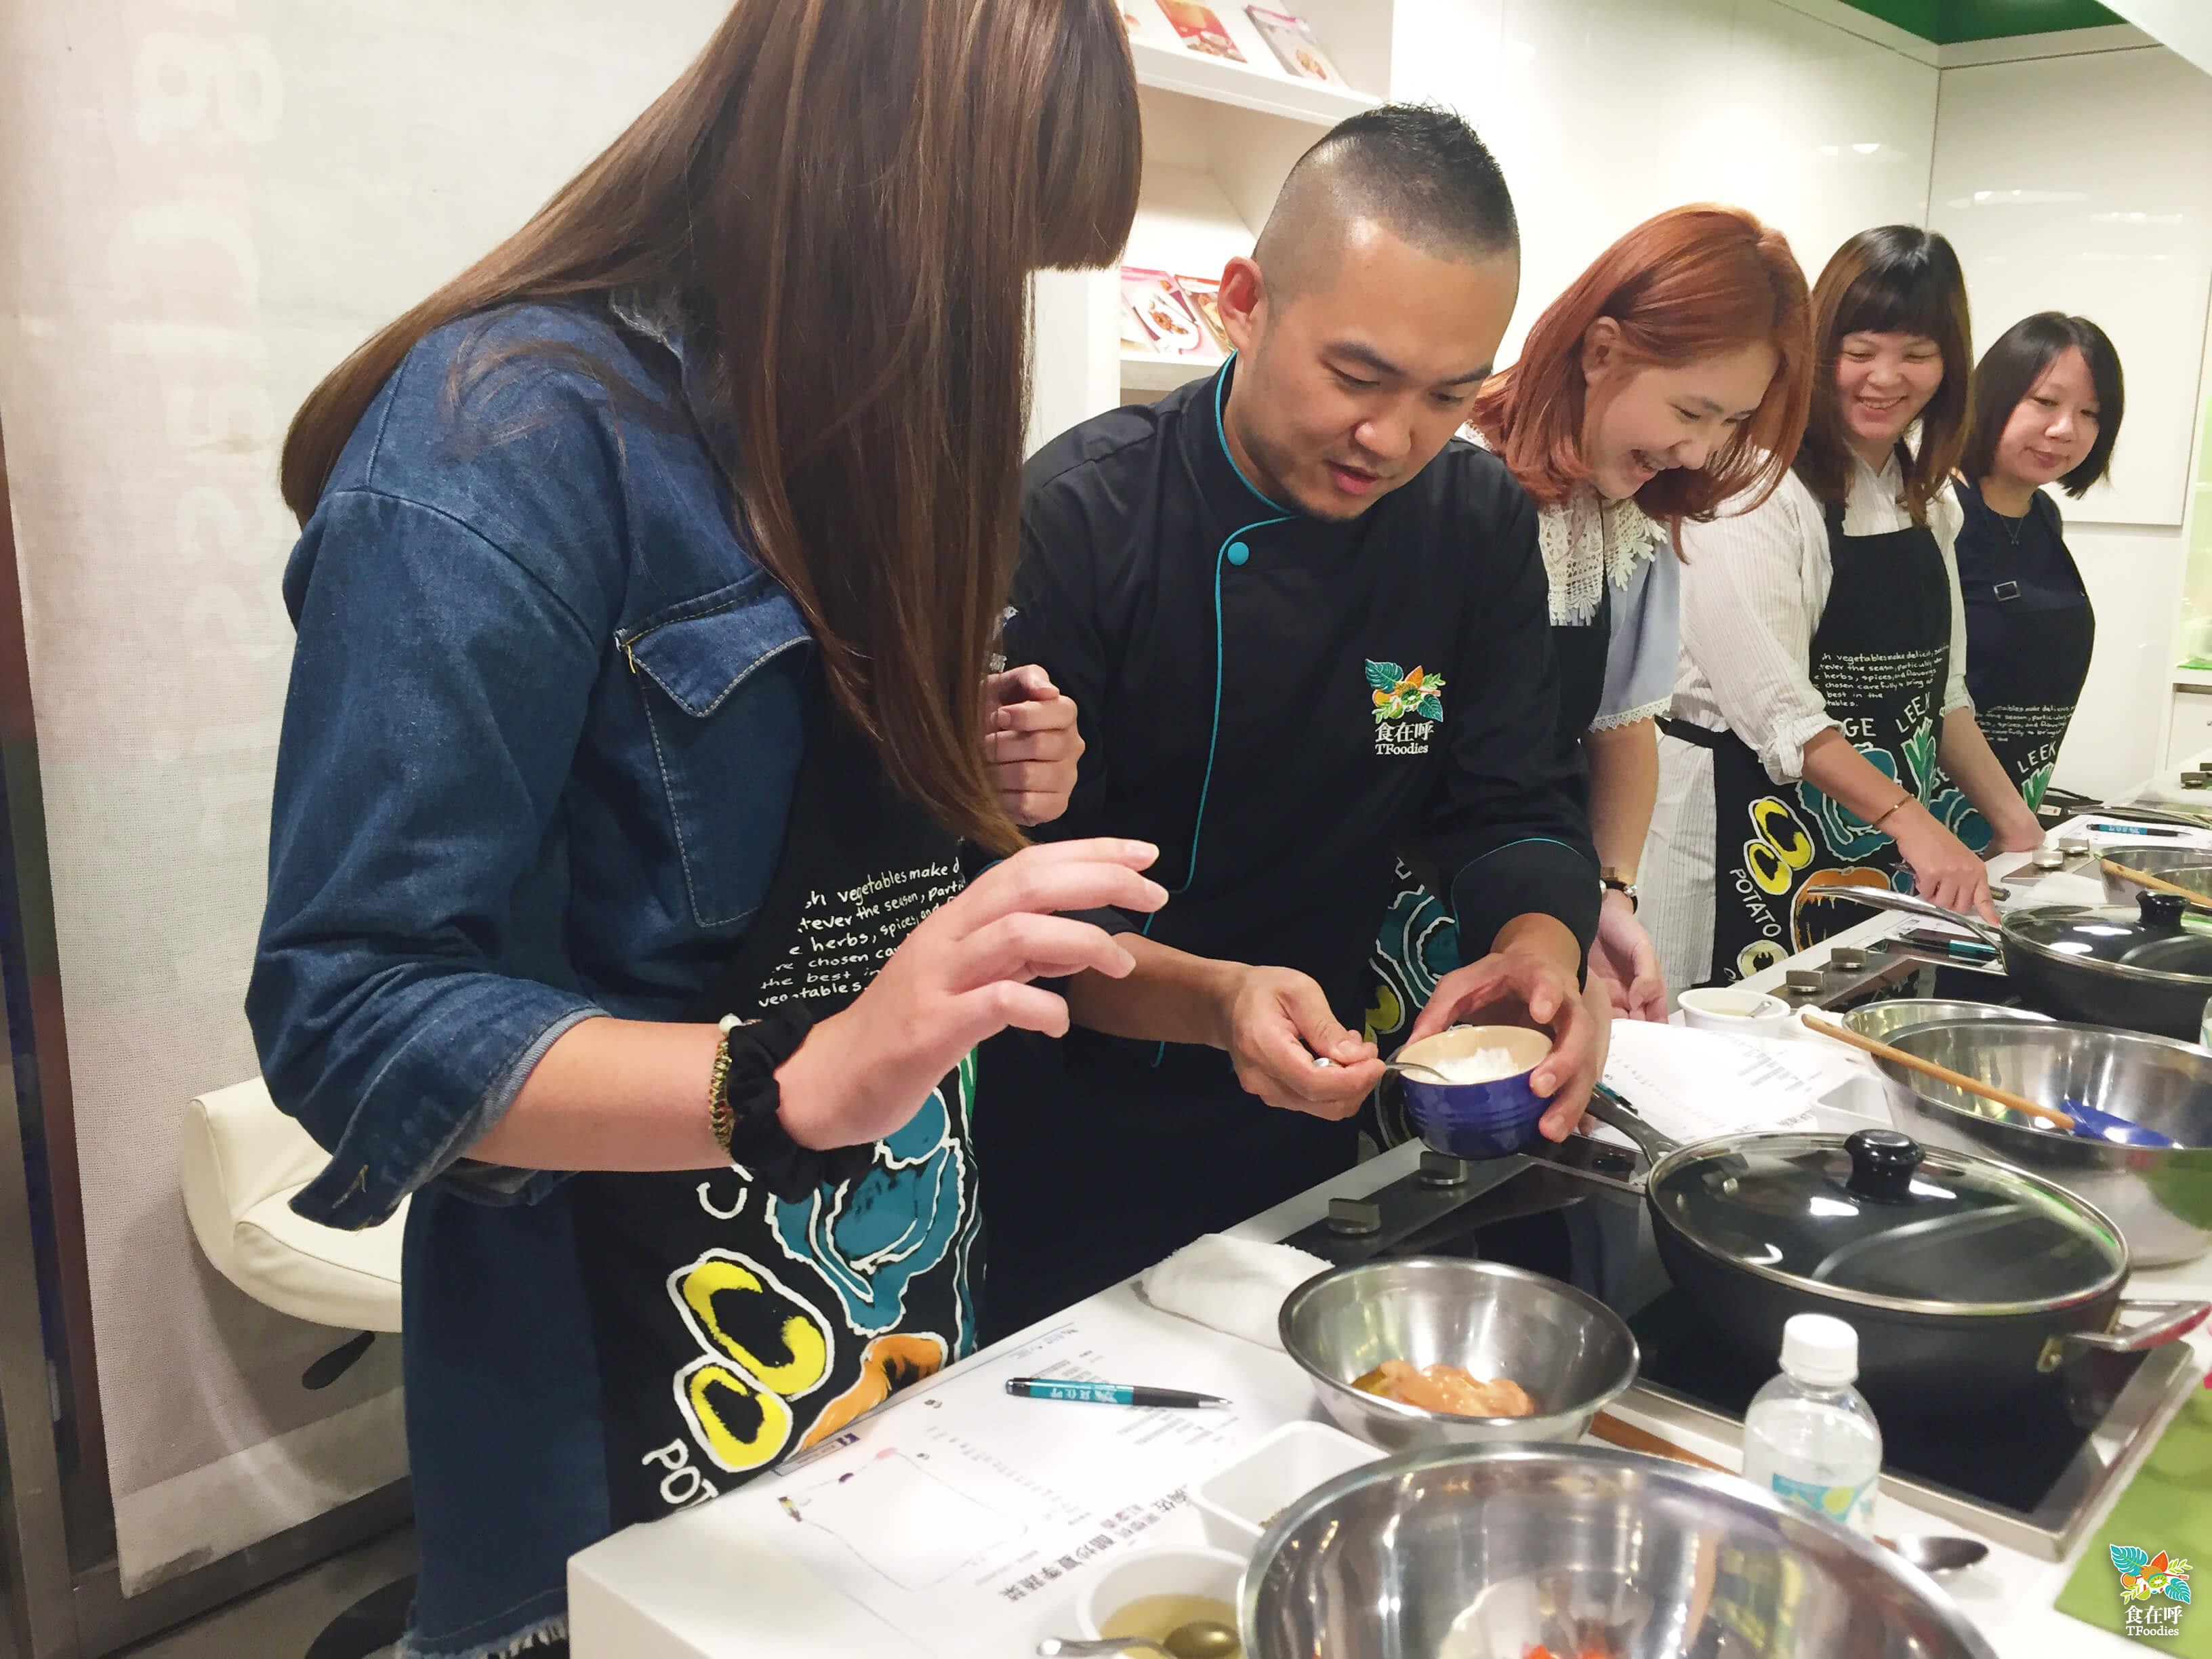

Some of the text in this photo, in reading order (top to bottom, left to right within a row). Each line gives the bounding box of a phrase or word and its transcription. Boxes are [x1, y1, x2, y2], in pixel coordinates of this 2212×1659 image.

[1837, 653, 1887, 665] vegetables
[1374, 720, 1435, 743] 食在呼
[1374, 742, 1429, 755] TFoodies
[2017, 741, 2057, 774] LEEK
[837, 869, 907, 907] vegetables
[909, 861, 949, 880] make
[856, 903, 880, 920] the
[1729, 868, 1782, 938] POTATO
[811, 932, 877, 952] herbs,
[808, 954, 869, 968] chosen
[760, 977, 794, 990] the
[806, 970, 852, 983] best
